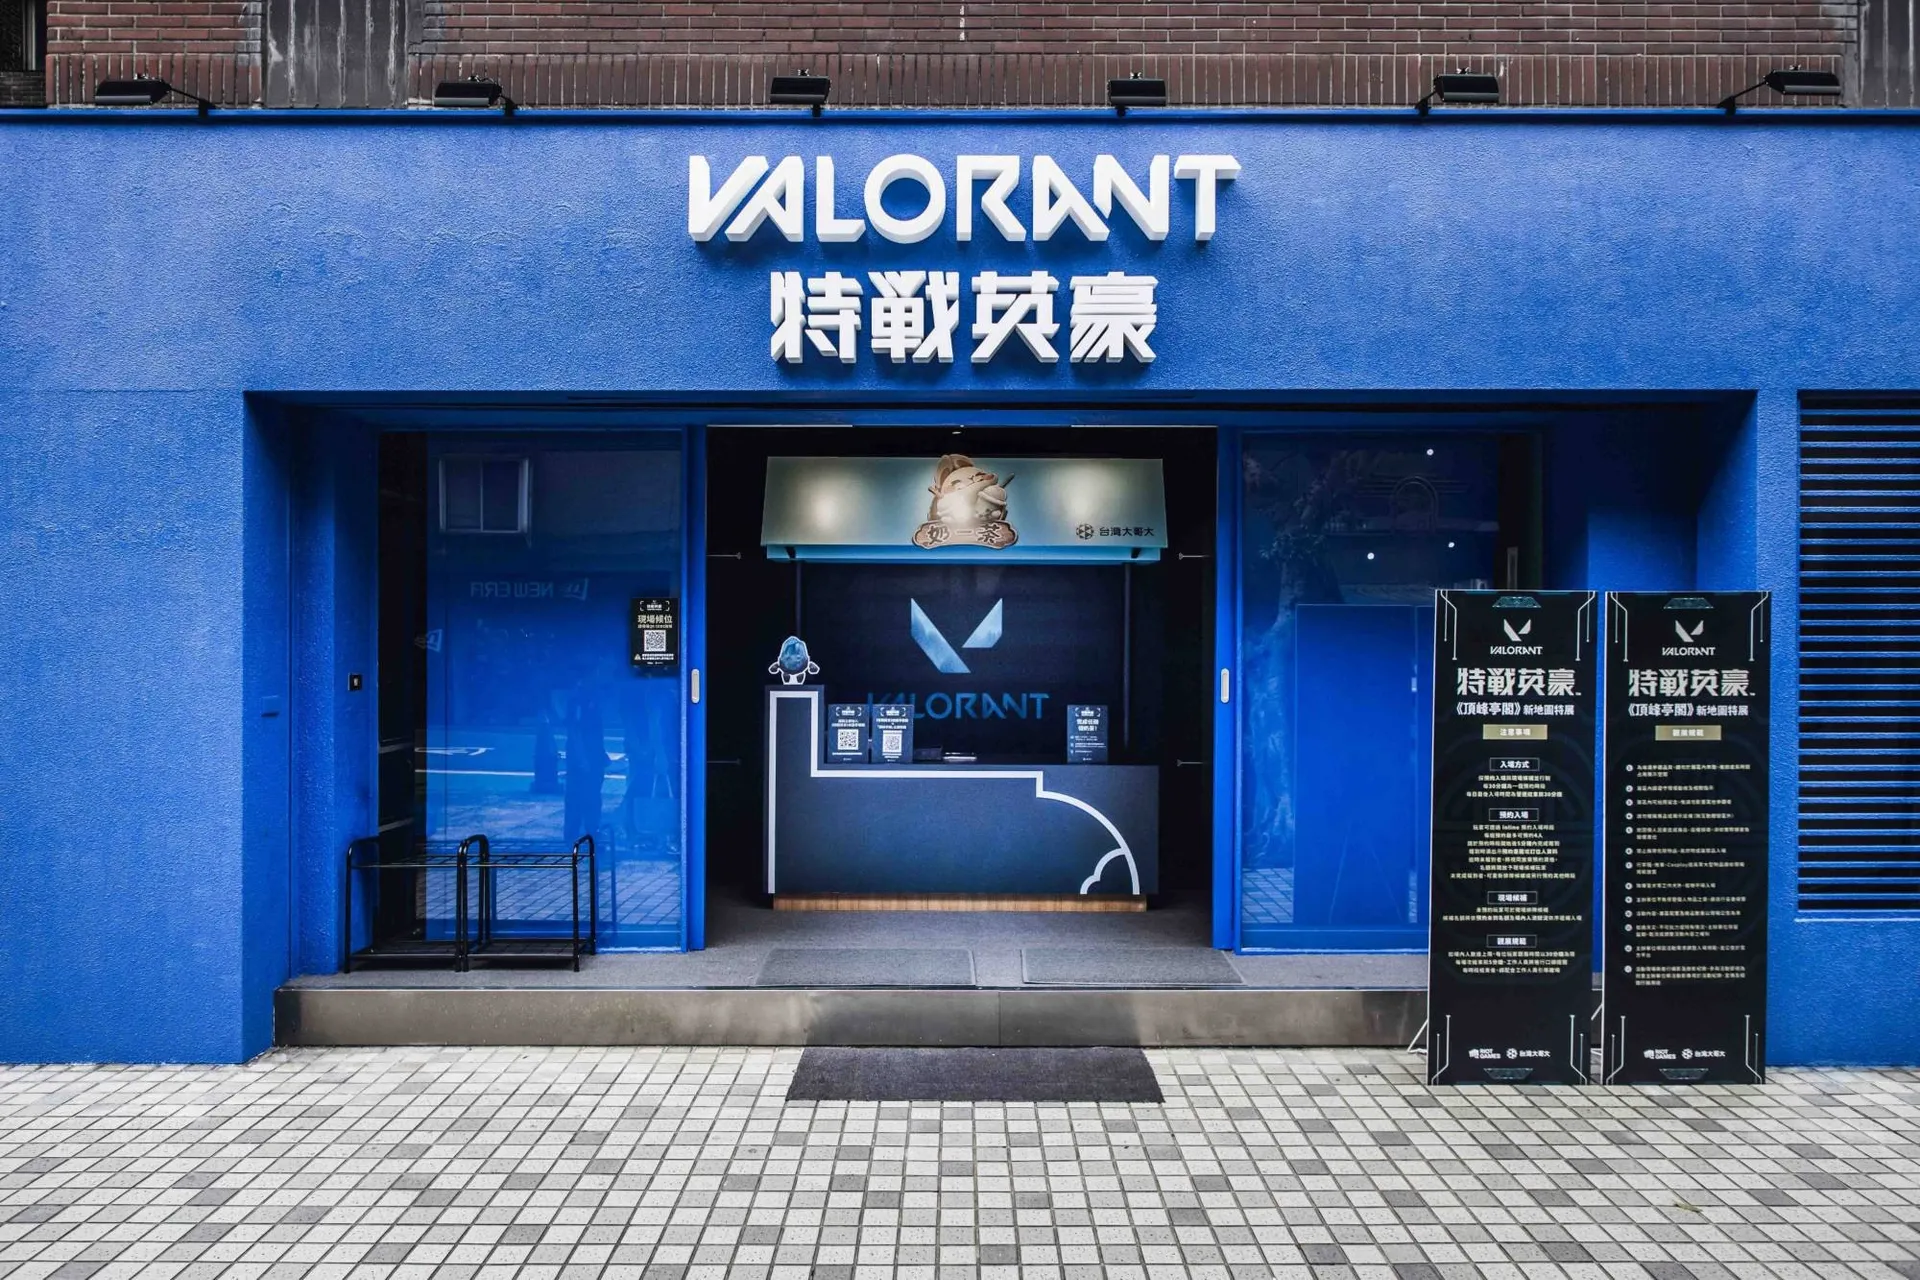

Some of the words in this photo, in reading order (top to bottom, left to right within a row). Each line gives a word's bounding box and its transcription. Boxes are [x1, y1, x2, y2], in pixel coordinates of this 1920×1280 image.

[688, 154, 1242, 243] VALORANT
[1490, 646, 1543, 655] VALORANT
[1662, 647, 1716, 656] VALORANT
[1500, 760, 1530, 769] 入場方式
[1499, 811, 1529, 819] 預約入場
